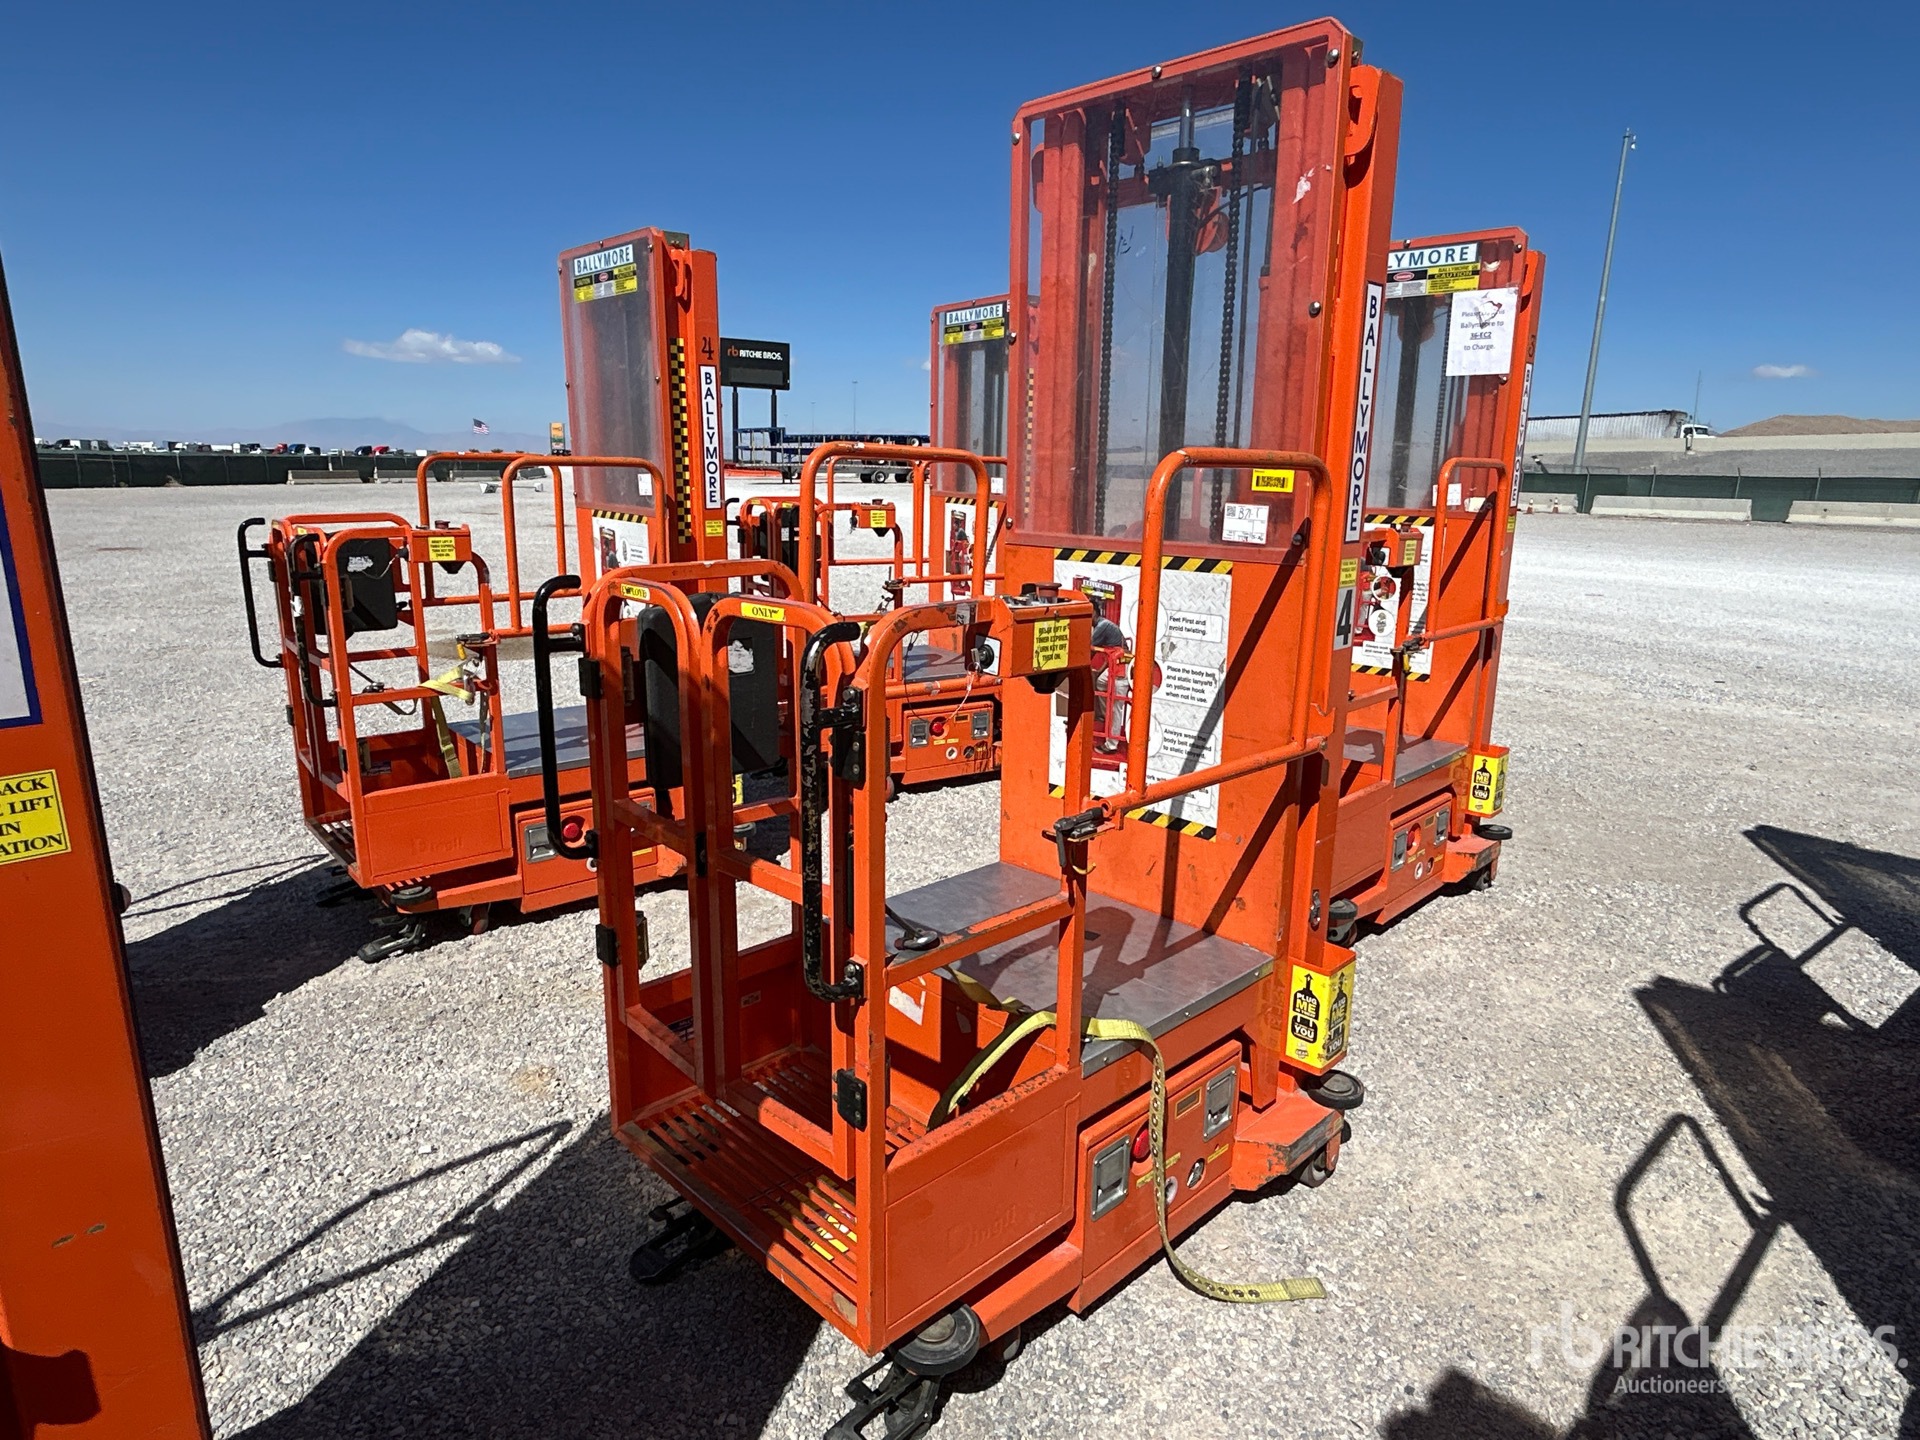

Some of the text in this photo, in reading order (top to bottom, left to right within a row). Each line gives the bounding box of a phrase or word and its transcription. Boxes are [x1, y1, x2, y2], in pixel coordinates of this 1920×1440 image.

[577, 247, 630, 273] BALLYMORE
[949, 305, 1000, 323] BALLYMORE
[701, 337, 714, 360] 4
[727, 345, 783, 360] rb RITCHIE BROS.
[1350, 295, 1377, 531] BALLYMORE
[704, 372, 718, 503] BALLYMORE
[1512, 369, 1531, 501] BALLYMORE
[752, 606, 774, 618] ONLY
[1170, 615, 1181, 623] Feet
[1337, 589, 1353, 646] 4
[1184, 627, 1208, 636] twisting.
[1191, 669, 1204, 677] body
[1192, 678, 1212, 686] lanyard
[1164, 728, 1182, 737] Always
[1164, 737, 1176, 745] body
[1170, 747, 1183, 755] static
[0, 777, 49, 796] ACK
[1474, 790, 1488, 799] YOU
[7, 795, 54, 815] LIFT
[1296, 998, 1316, 1014] ME
[1297, 992, 1317, 1005] PLUG
[1294, 1024, 1314, 1039] YOU
[1329, 1037, 1343, 1053] YOU
